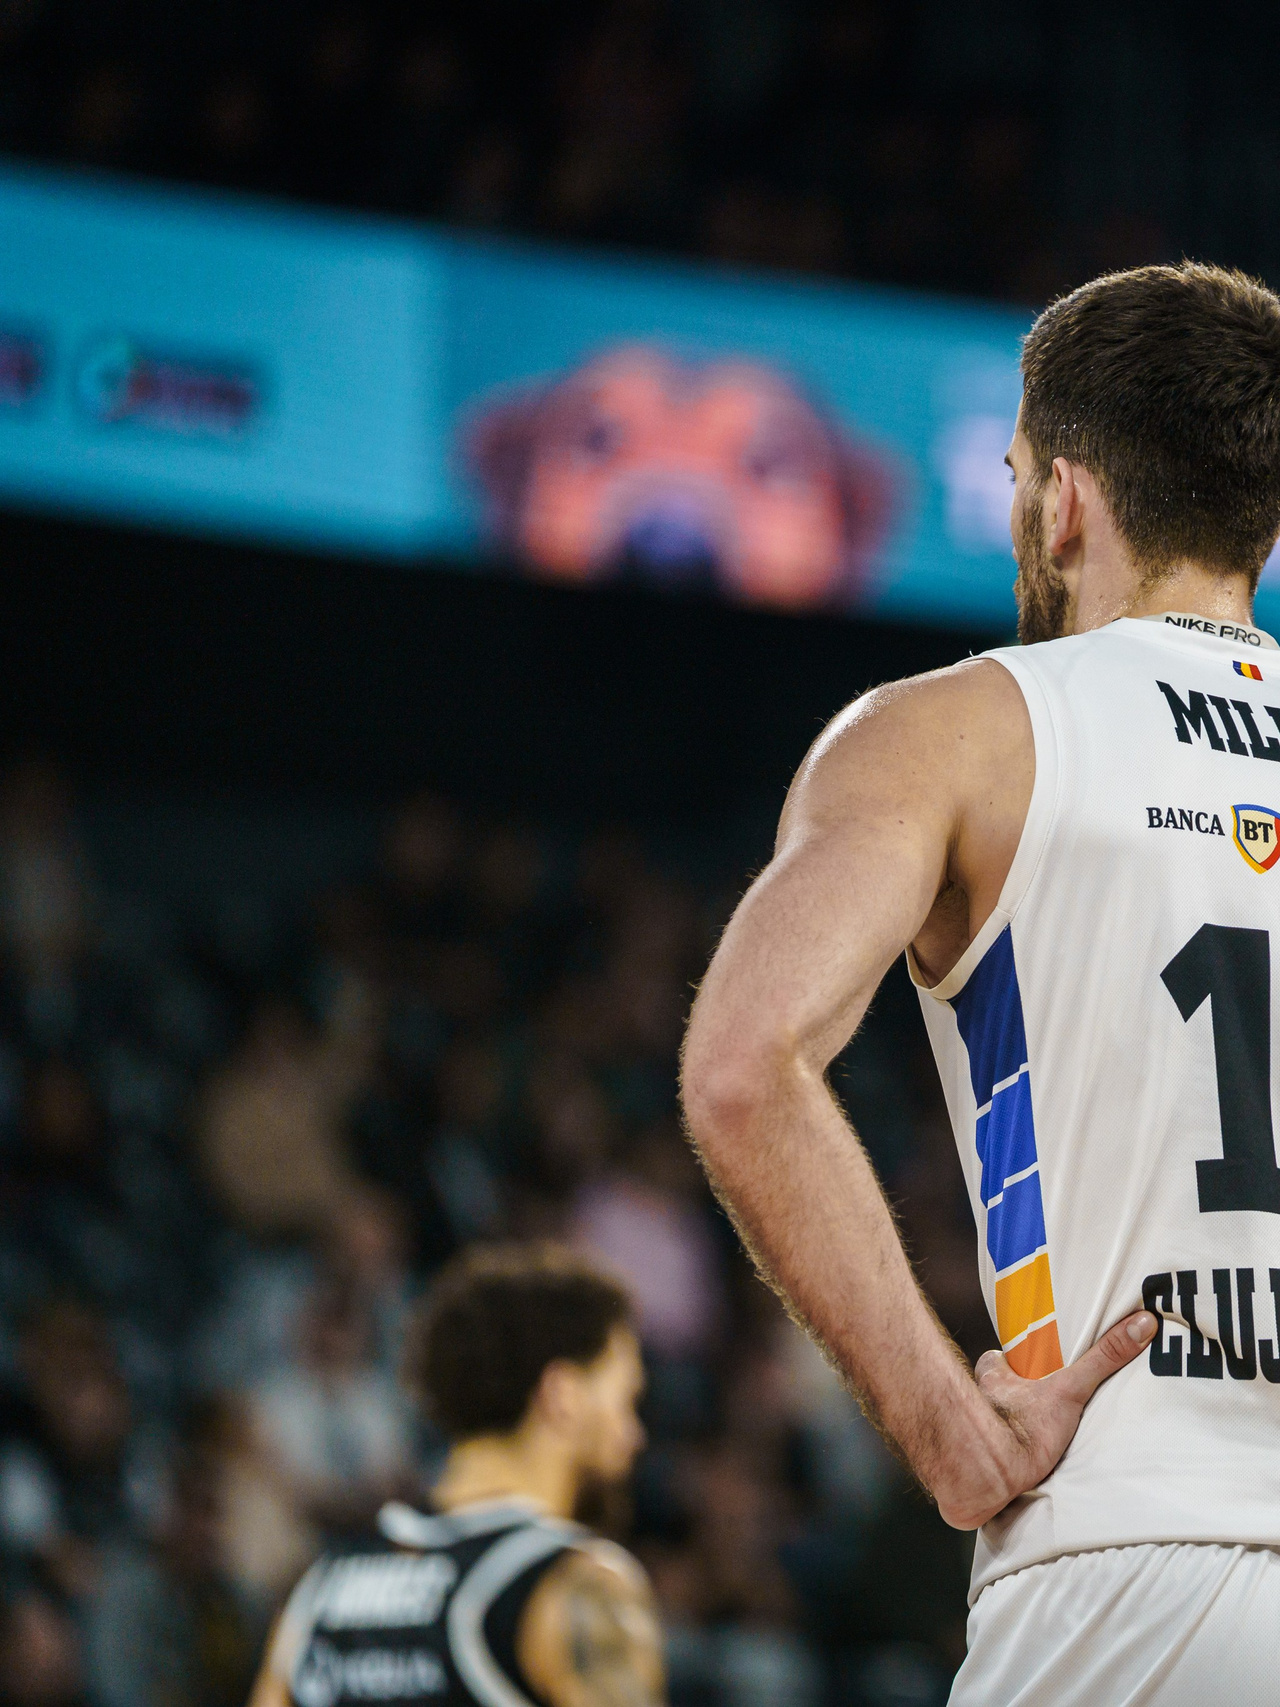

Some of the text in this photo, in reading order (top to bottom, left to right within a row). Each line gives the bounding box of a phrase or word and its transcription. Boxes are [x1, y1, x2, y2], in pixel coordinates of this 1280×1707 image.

[1165, 616, 1260, 647] NIKE PRO
[1146, 807, 1225, 836] BANCA
[1242, 819, 1273, 843] BT
